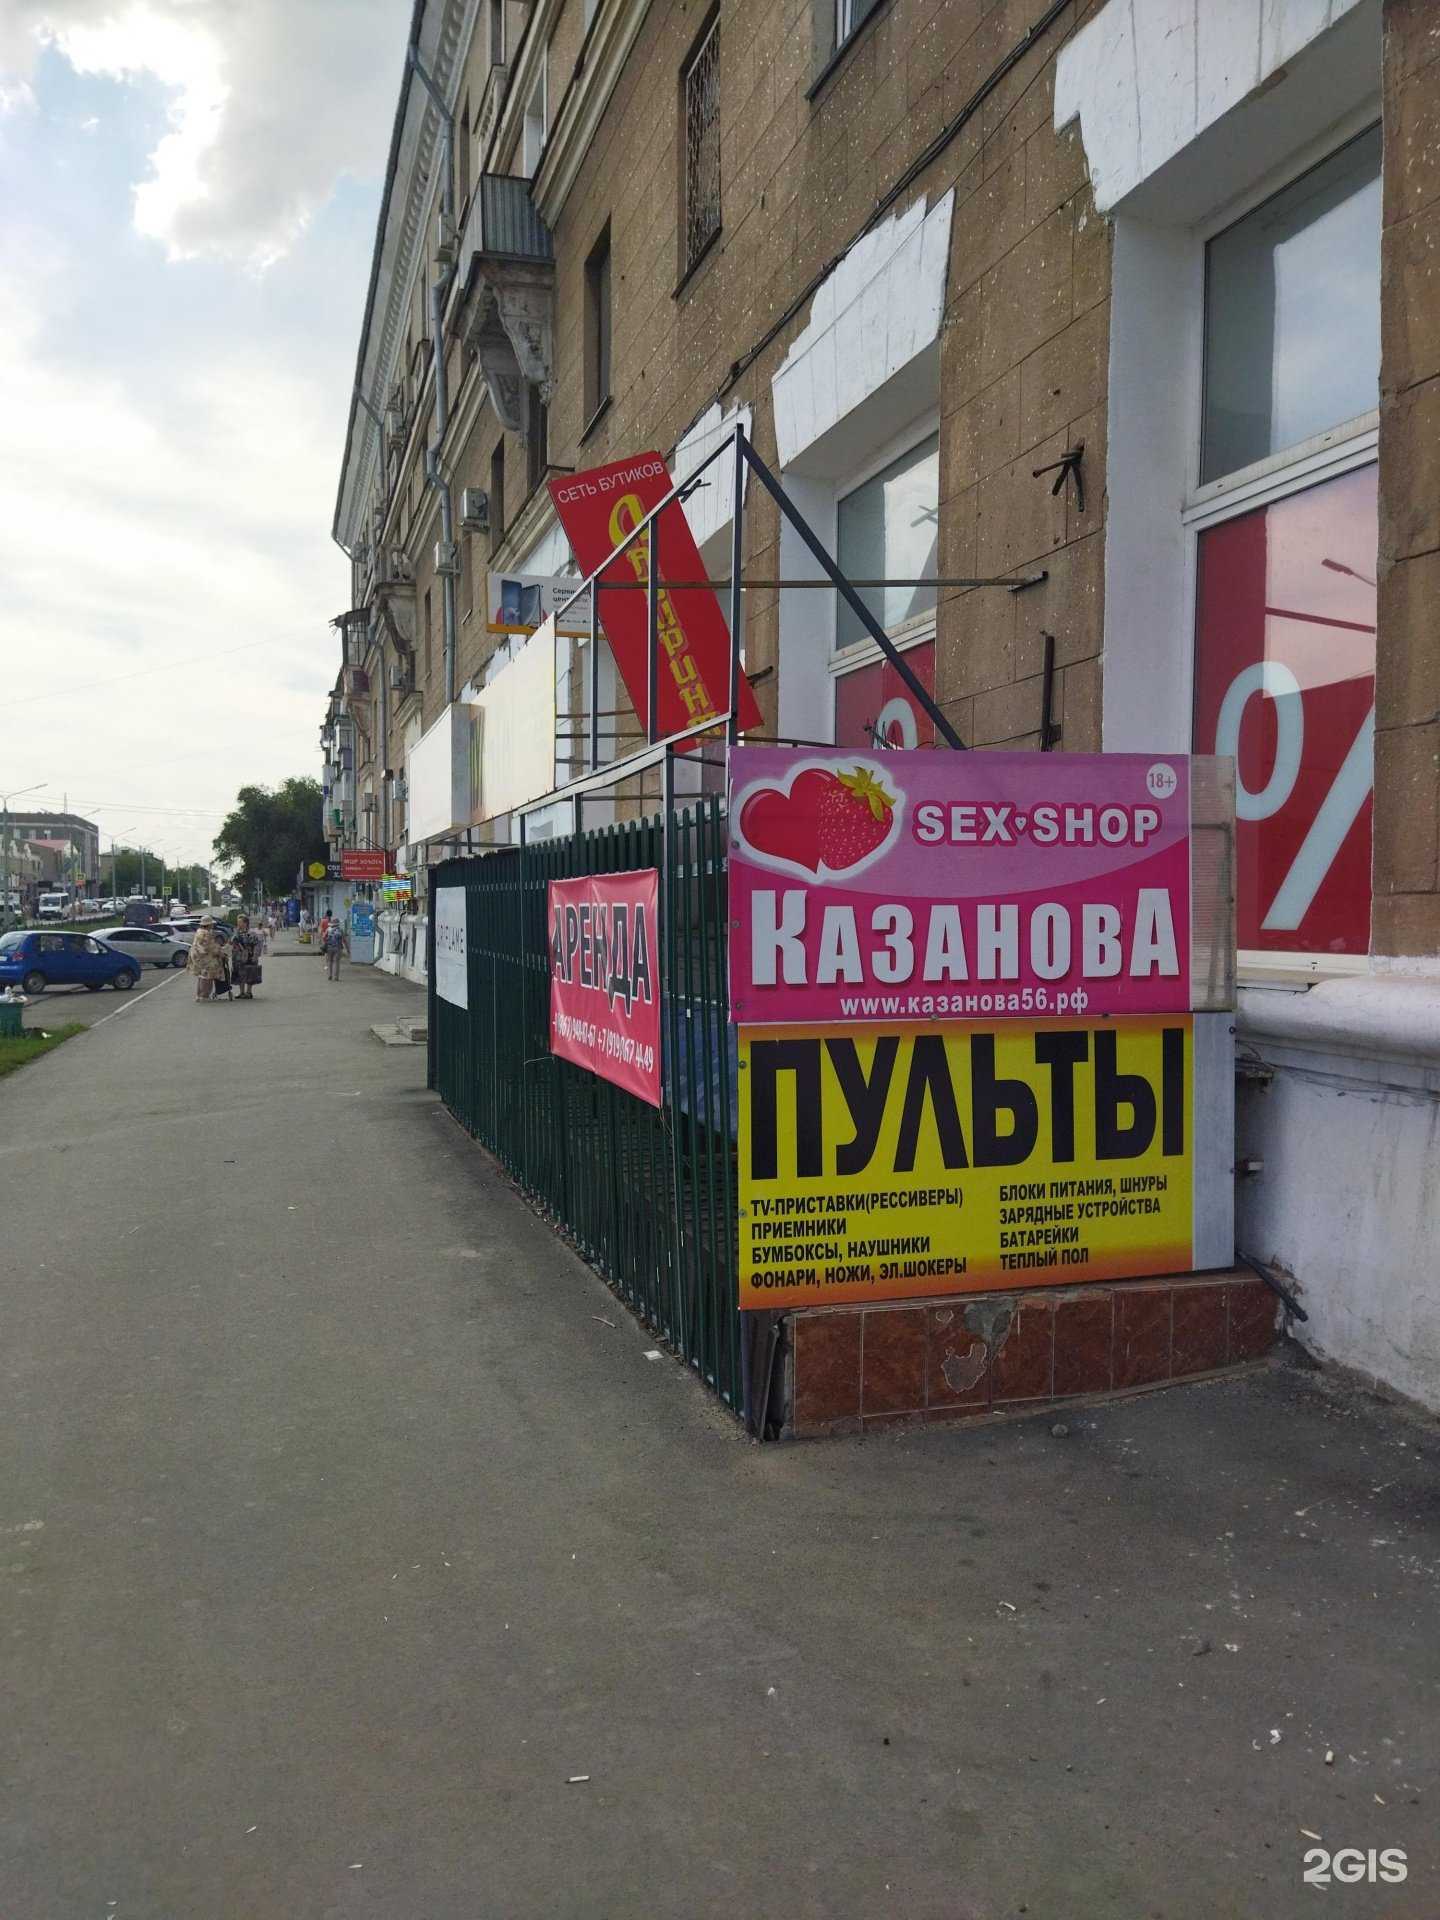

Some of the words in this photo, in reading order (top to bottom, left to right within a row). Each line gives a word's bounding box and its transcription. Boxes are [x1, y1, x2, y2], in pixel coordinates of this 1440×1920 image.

[558, 484, 597, 503] СЕТЬ
[599, 461, 664, 491] БУТИКОВ
[1149, 773, 1174, 788] 18+
[751, 888, 1180, 985] КАЗАНОВА
[552, 903, 653, 1018] АРЕНДА
[840, 986, 1089, 1015] www.казанова56.рф
[750, 1028, 1185, 1181] ПУЛЬТЫ
[751, 1188, 963, 1216] TV-ПРИСТАВКИ(РЕССИВЕРЫ)
[1000, 1183, 1046, 1201] БЛОКИ
[1050, 1178, 1117, 1198] ПИТАНИЯ,
[1120, 1175, 1168, 1193] ШНУРЫ
[1000, 1203, 1074, 1225] ЗАРЯДНЫЕ
[1077, 1197, 1161, 1219] УСТРОЙСТВА
[751, 1218, 847, 1240] ПРИЕМНИКИ
[1000, 1225, 1079, 1248] БАТАРЕЙКИ
[752, 1242, 843, 1264] БУМБОКСЫ,
[848, 1237, 930, 1258] НАУШНИКИ
[1000, 1247, 1057, 1270] ТЕПЛЫЙ
[1061, 1248, 1089, 1265] ПОЛ
[751, 1269, 821, 1289] ФОНАРИ,
[825, 1265, 875, 1284] НОЖИ,
[880, 1257, 967, 1280] ЭЛ.ШОКЕРЫ
